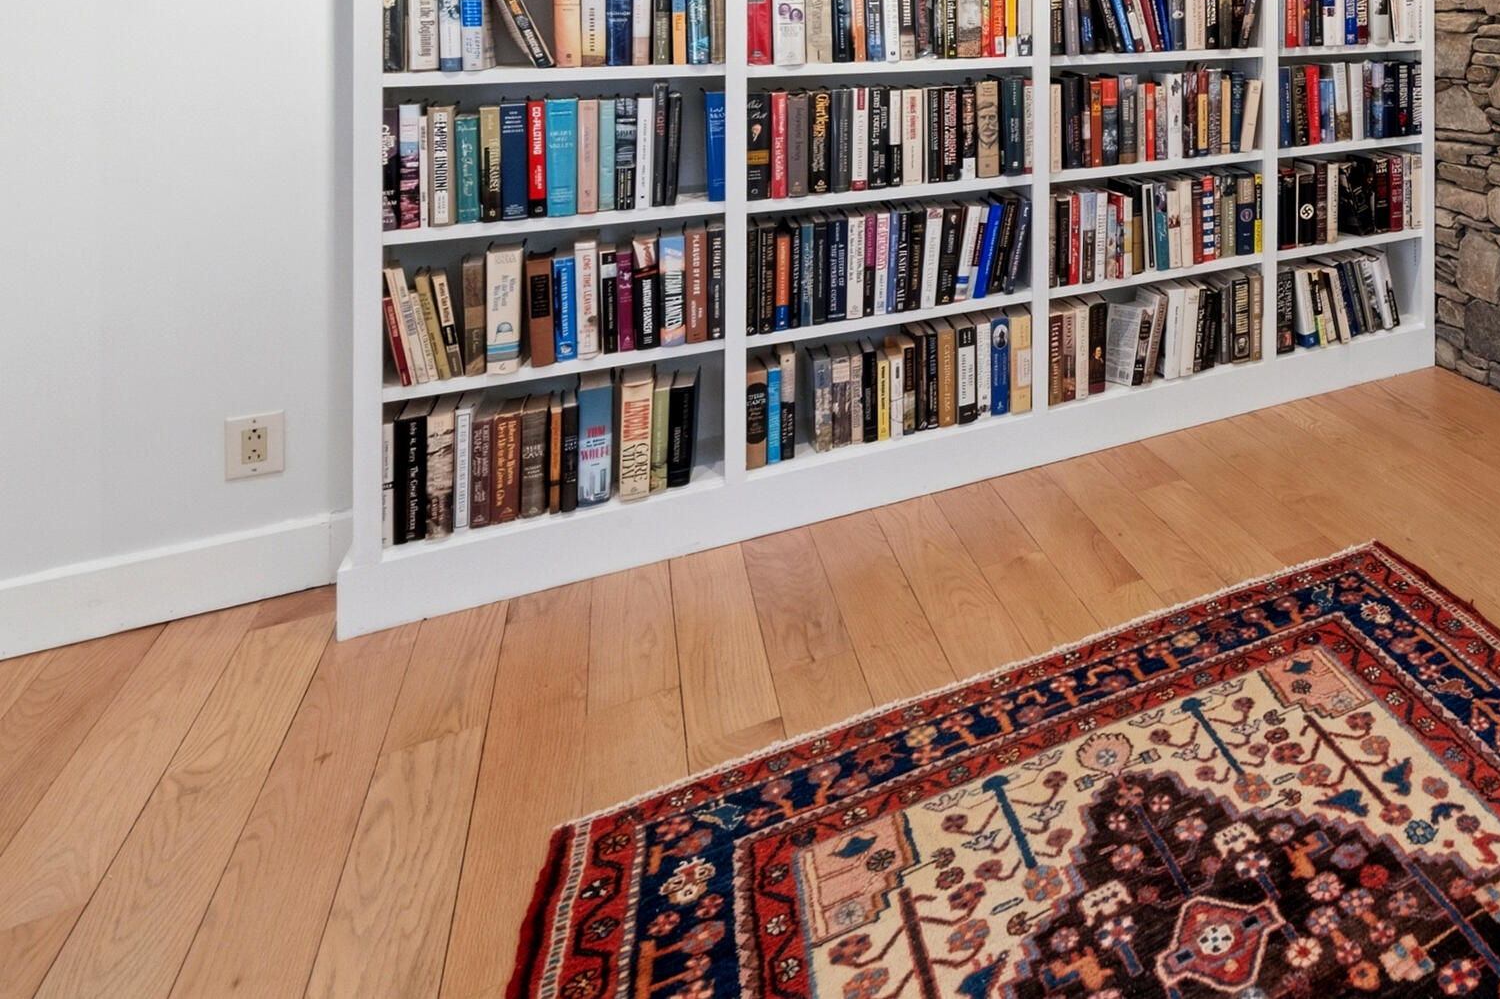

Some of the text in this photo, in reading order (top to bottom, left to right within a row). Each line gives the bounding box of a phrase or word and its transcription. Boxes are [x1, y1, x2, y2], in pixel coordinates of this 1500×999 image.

[418, 6, 438, 57] the Beginning
[435, 121, 448, 193] EMPIRE UNDONE
[583, 254, 592, 270] LONG
[692, 234, 701, 267] PLAGUED
[583, 273, 592, 288] TIME
[692, 279, 701, 296] FIRE
[663, 295, 684, 331] FRANZEN
[1281, 280, 1293, 322] SUPREME
[642, 306, 654, 334] FRANZEN
[506, 420, 517, 443] Robert
[623, 398, 650, 443] LINCOLN
[506, 443, 516, 459] Penn
[620, 444, 636, 485] VIDAL
[633, 442, 650, 483] GORE
[410, 465, 419, 477] The
[495, 467, 505, 488] Green
[494, 488, 506, 507] Glen
